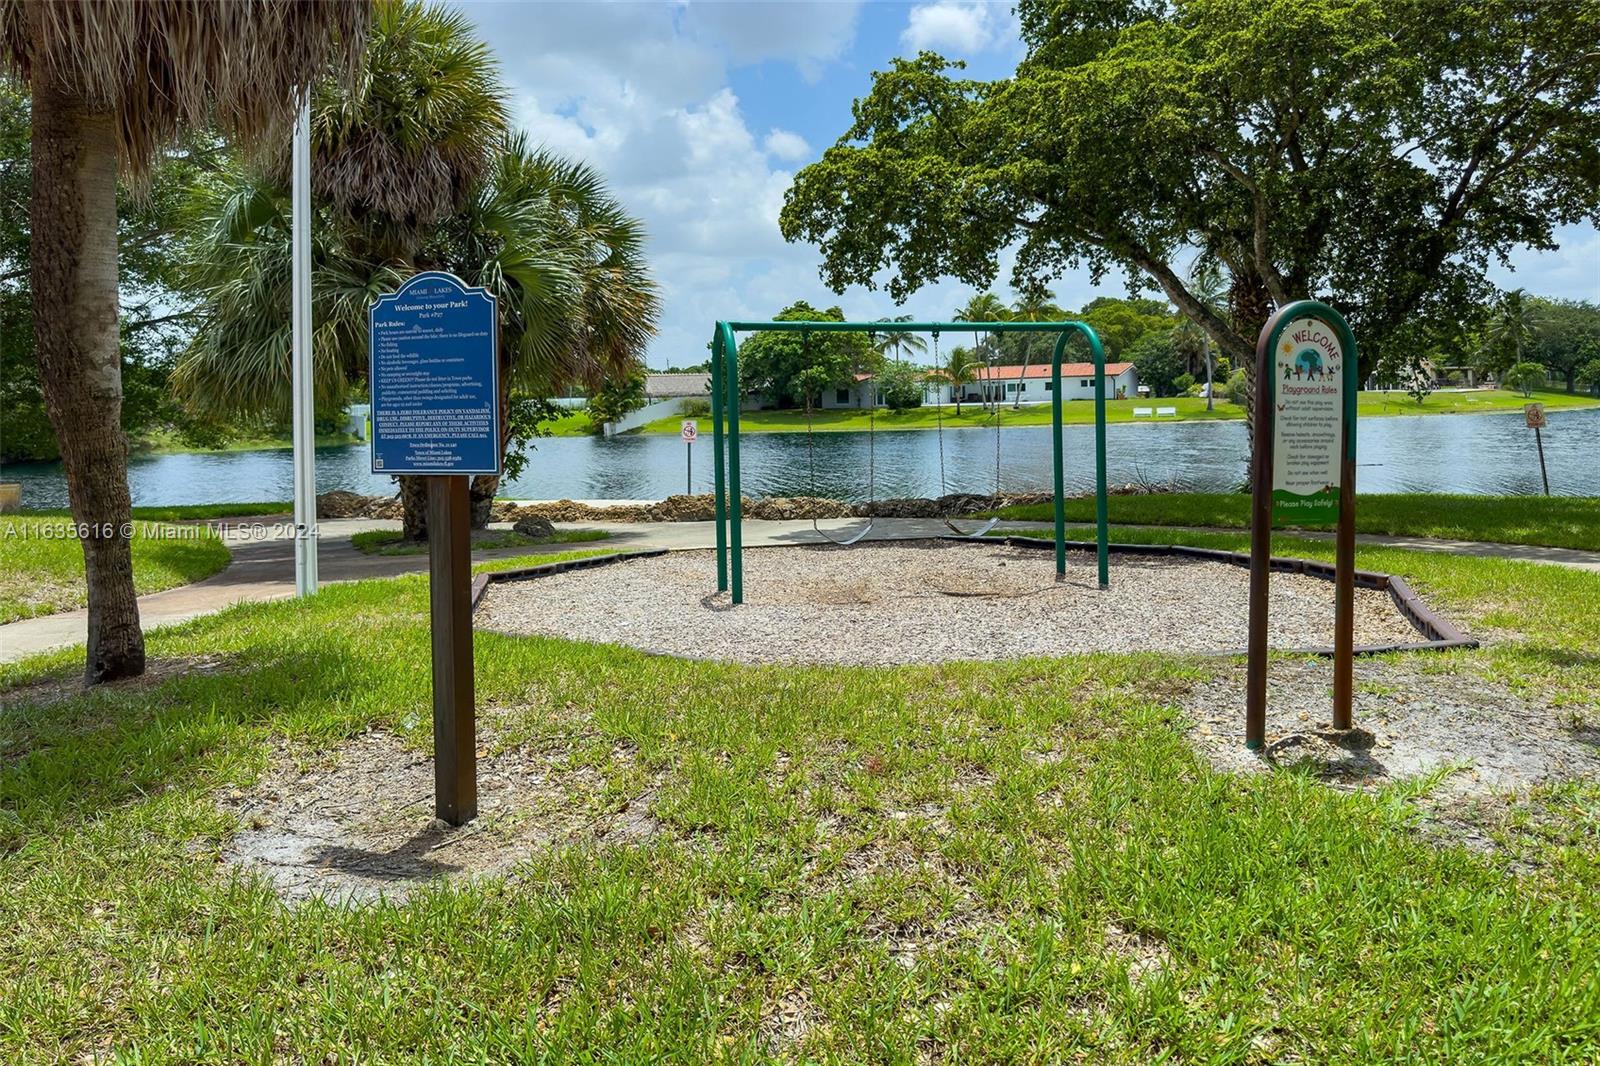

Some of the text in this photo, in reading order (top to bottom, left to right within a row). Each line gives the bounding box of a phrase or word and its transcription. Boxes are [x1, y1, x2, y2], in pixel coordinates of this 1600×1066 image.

[1292, 330, 1339, 360] WELCOME
[1282, 384, 1337, 395] Playground Rules
[1300, 500, 1312, 508] Play
[1314, 499, 1333, 508] Safely!
